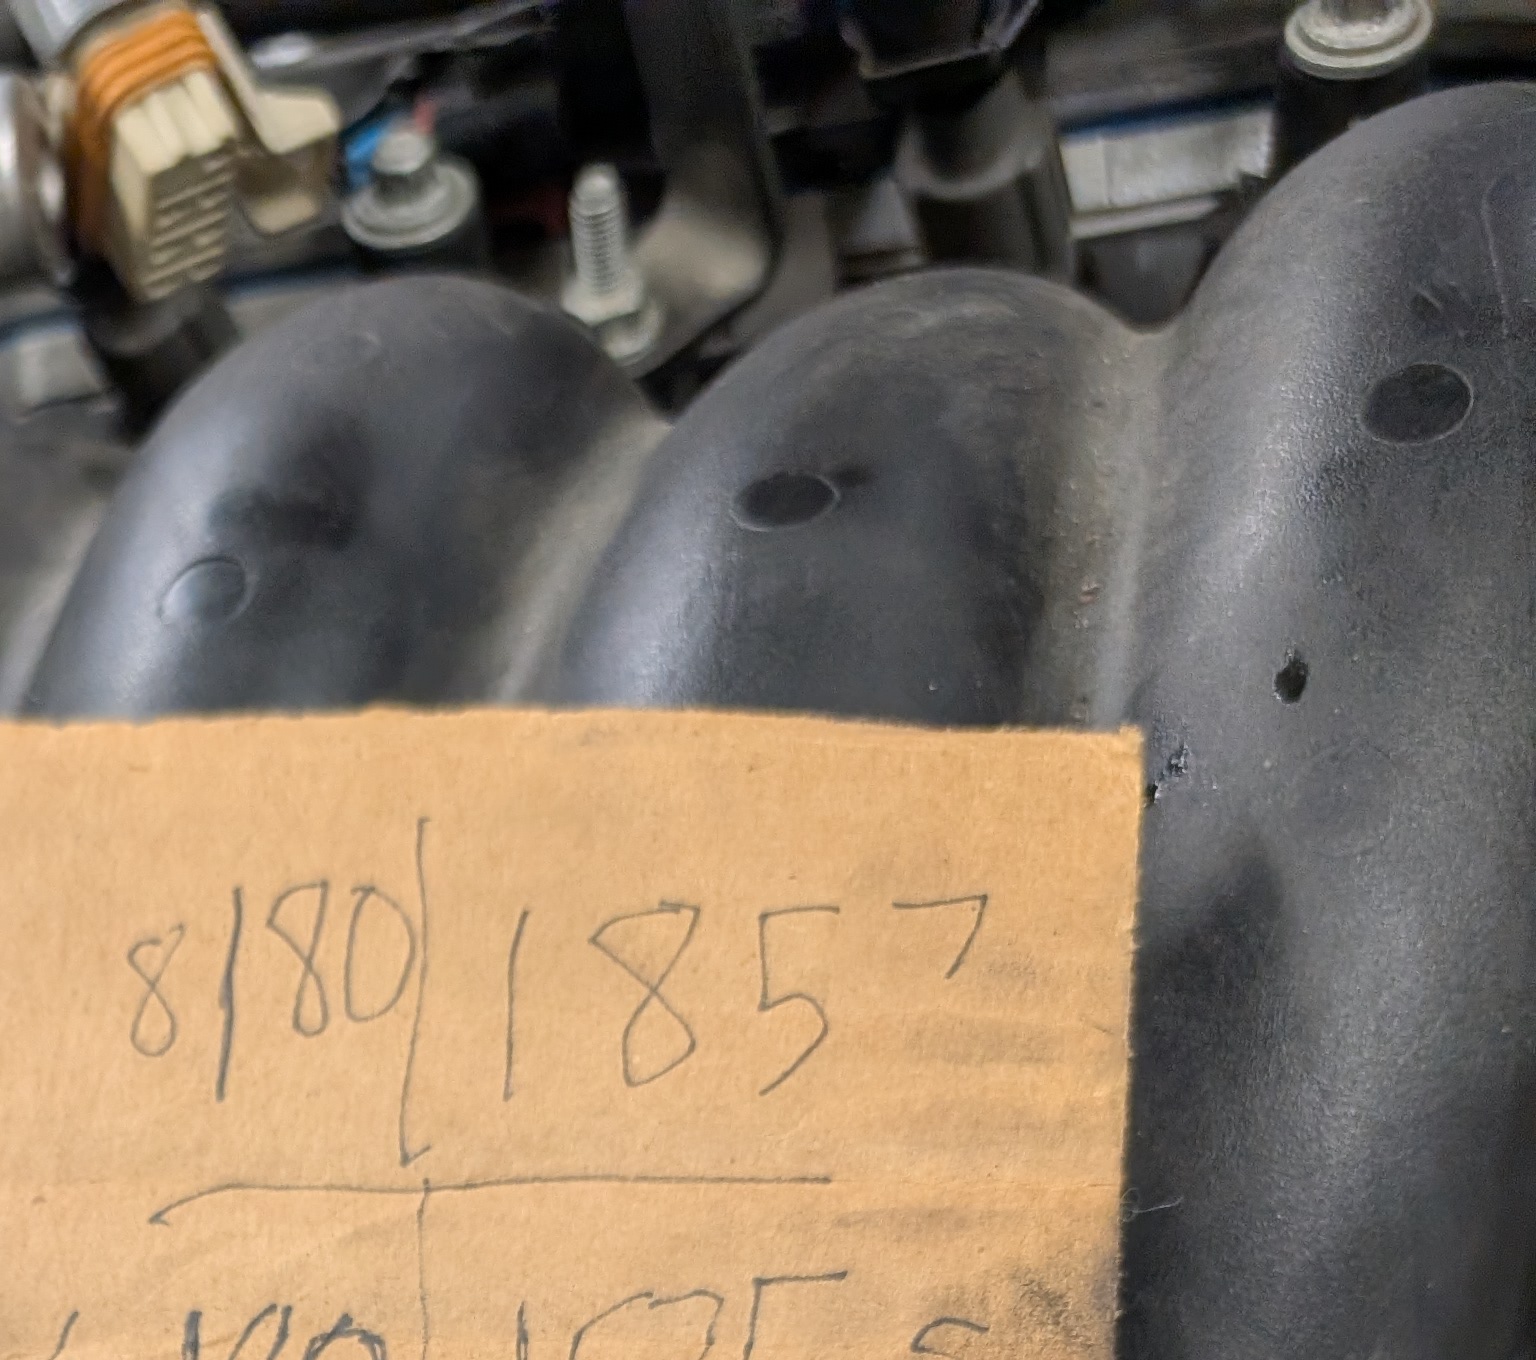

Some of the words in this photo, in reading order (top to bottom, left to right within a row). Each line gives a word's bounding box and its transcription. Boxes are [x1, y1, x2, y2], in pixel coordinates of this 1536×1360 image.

[128, 926, 184, 1058] 8
[216, 880, 414, 1102] 180
[503, 902, 840, 1102] 185
[892, 893, 988, 978] 7
